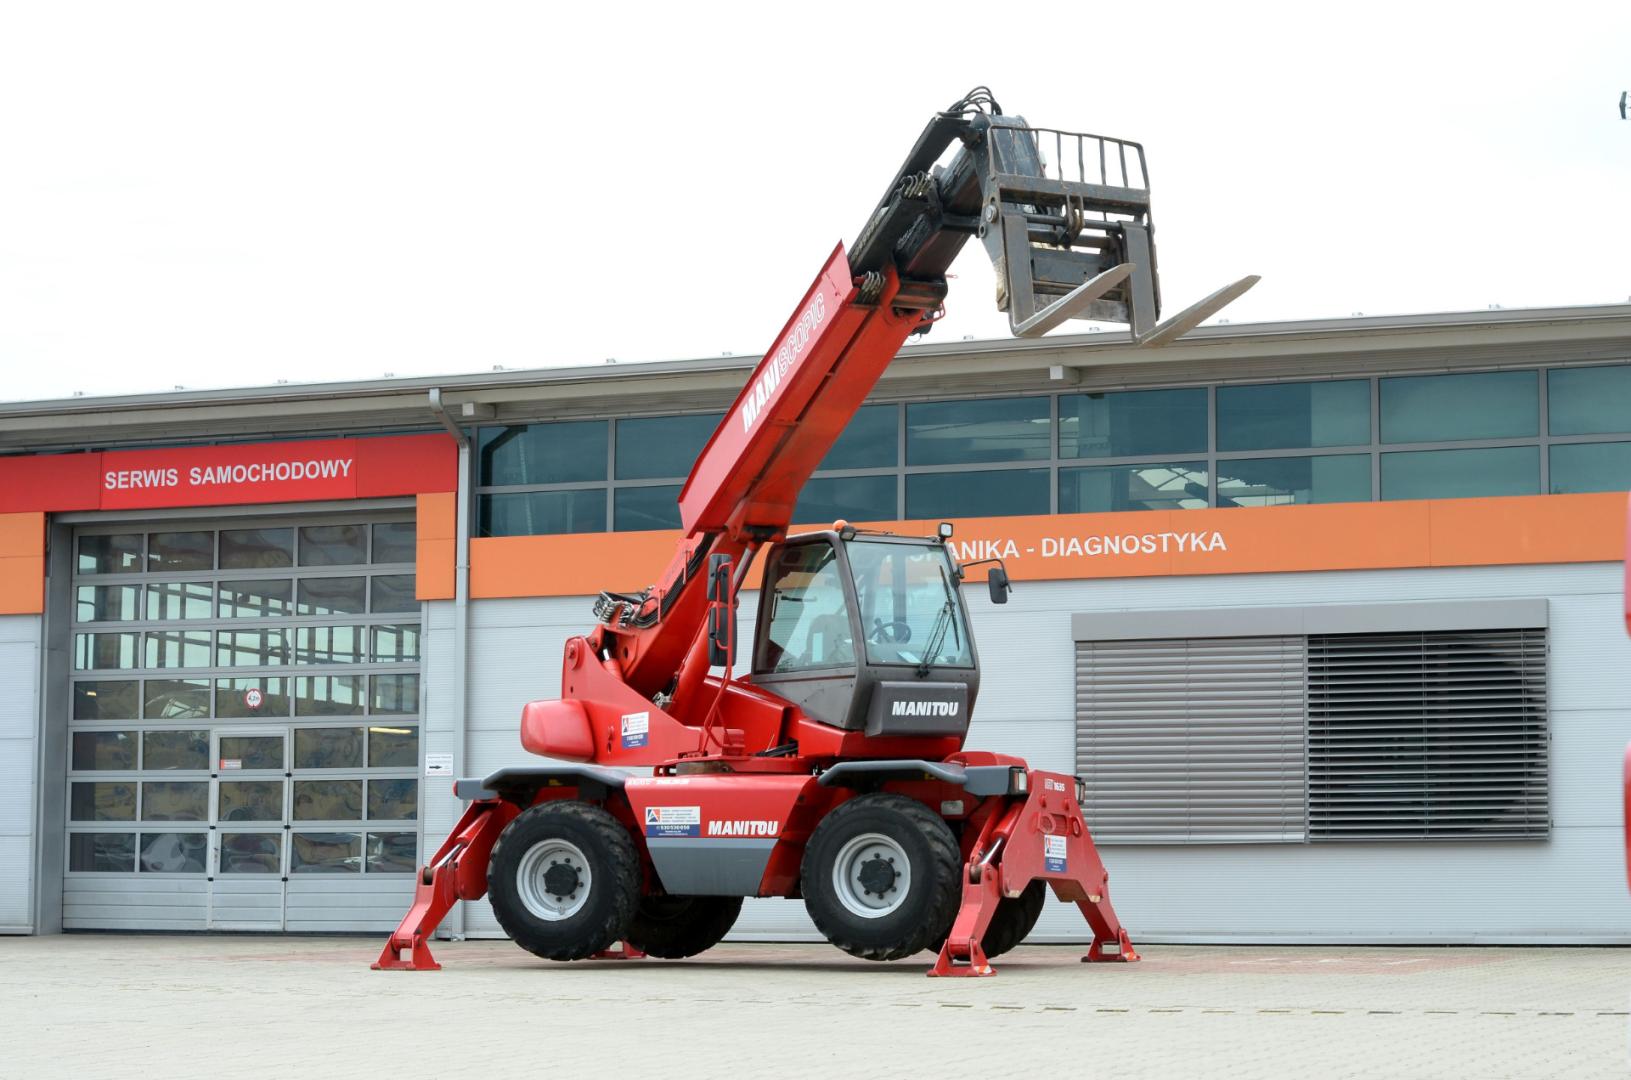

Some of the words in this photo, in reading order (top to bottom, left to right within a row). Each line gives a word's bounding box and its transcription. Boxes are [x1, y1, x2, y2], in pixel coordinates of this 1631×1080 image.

[742, 292, 825, 433] MANISCOPIC
[105, 468, 178, 489] SERWIS
[189, 459, 352, 485] SAMOCHODOWY
[1041, 531, 1227, 557] DIAGNOSTYKA
[892, 701, 959, 716] MANITOU
[708, 820, 779, 835] MANITOU
